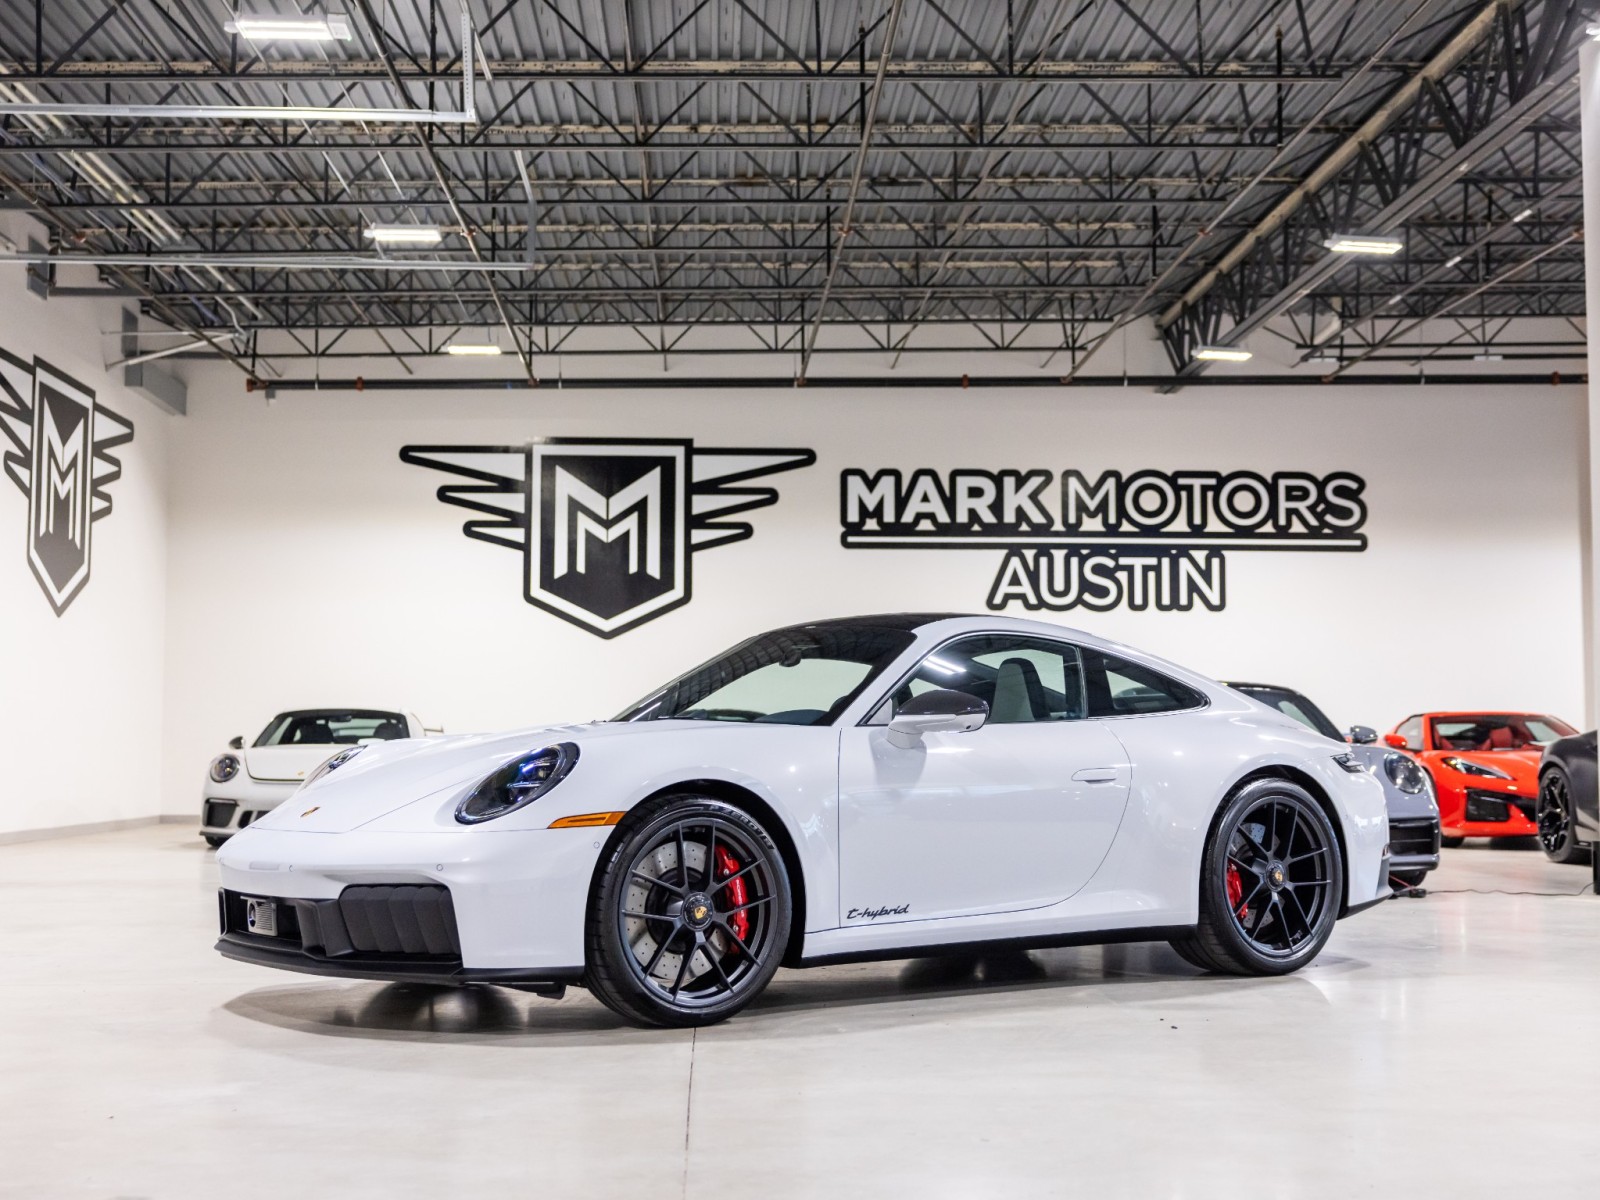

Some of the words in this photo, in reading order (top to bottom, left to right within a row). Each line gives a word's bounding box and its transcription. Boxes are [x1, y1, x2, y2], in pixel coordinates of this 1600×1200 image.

[845, 472, 1049, 525] MARK
[1066, 473, 1364, 530] MOTORS
[991, 554, 1223, 607] AUSTIN
[846, 903, 910, 920] t-hybrid
